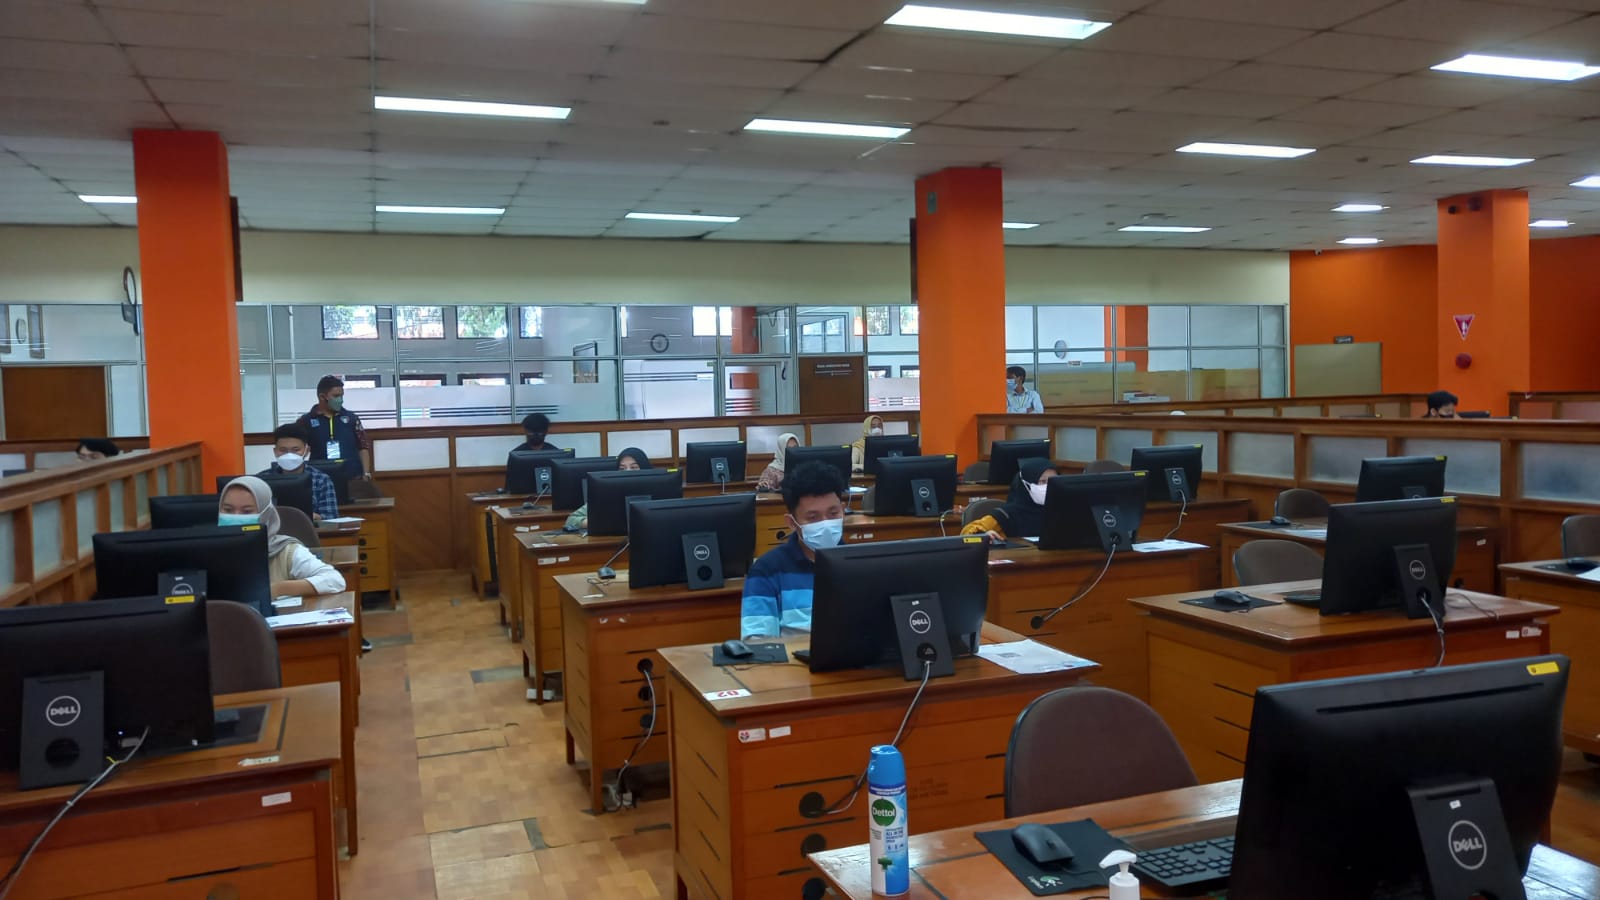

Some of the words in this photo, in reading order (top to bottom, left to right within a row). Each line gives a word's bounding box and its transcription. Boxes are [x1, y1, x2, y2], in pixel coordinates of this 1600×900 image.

[50, 707, 77, 717] DELL
[872, 806, 896, 817] Dettol
[1453, 837, 1483, 853] DELL
